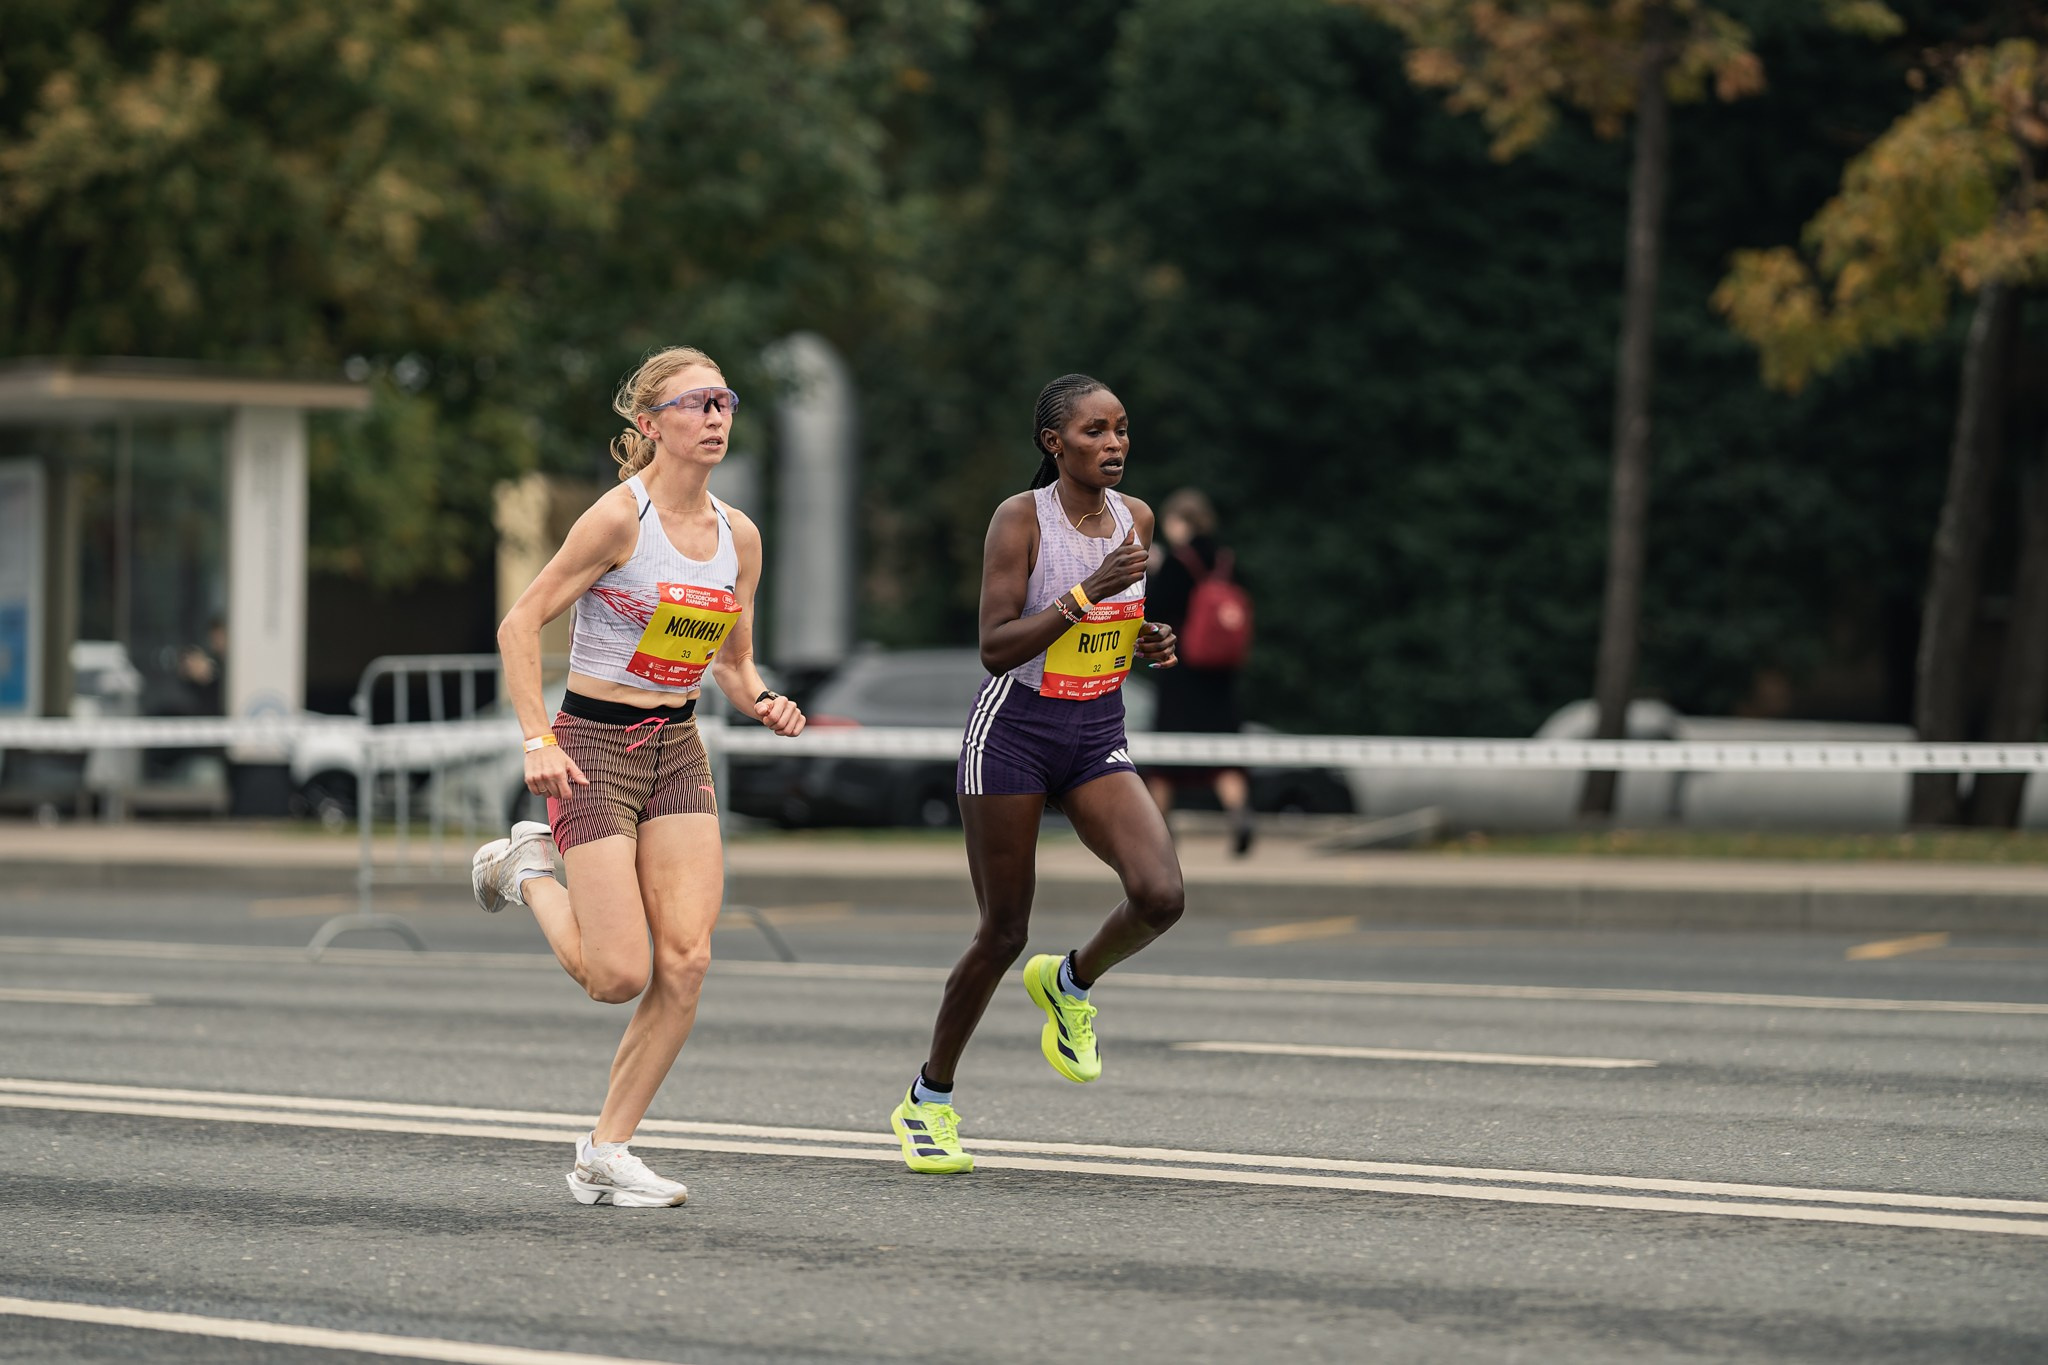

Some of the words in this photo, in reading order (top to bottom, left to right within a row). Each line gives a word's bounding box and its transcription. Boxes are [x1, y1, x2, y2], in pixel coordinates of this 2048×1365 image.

[664, 616, 726, 642] МОКИНА
[1078, 630, 1121, 653] RUTTO
[681, 650, 691, 658] 33
[1093, 664, 1101, 672] 32
